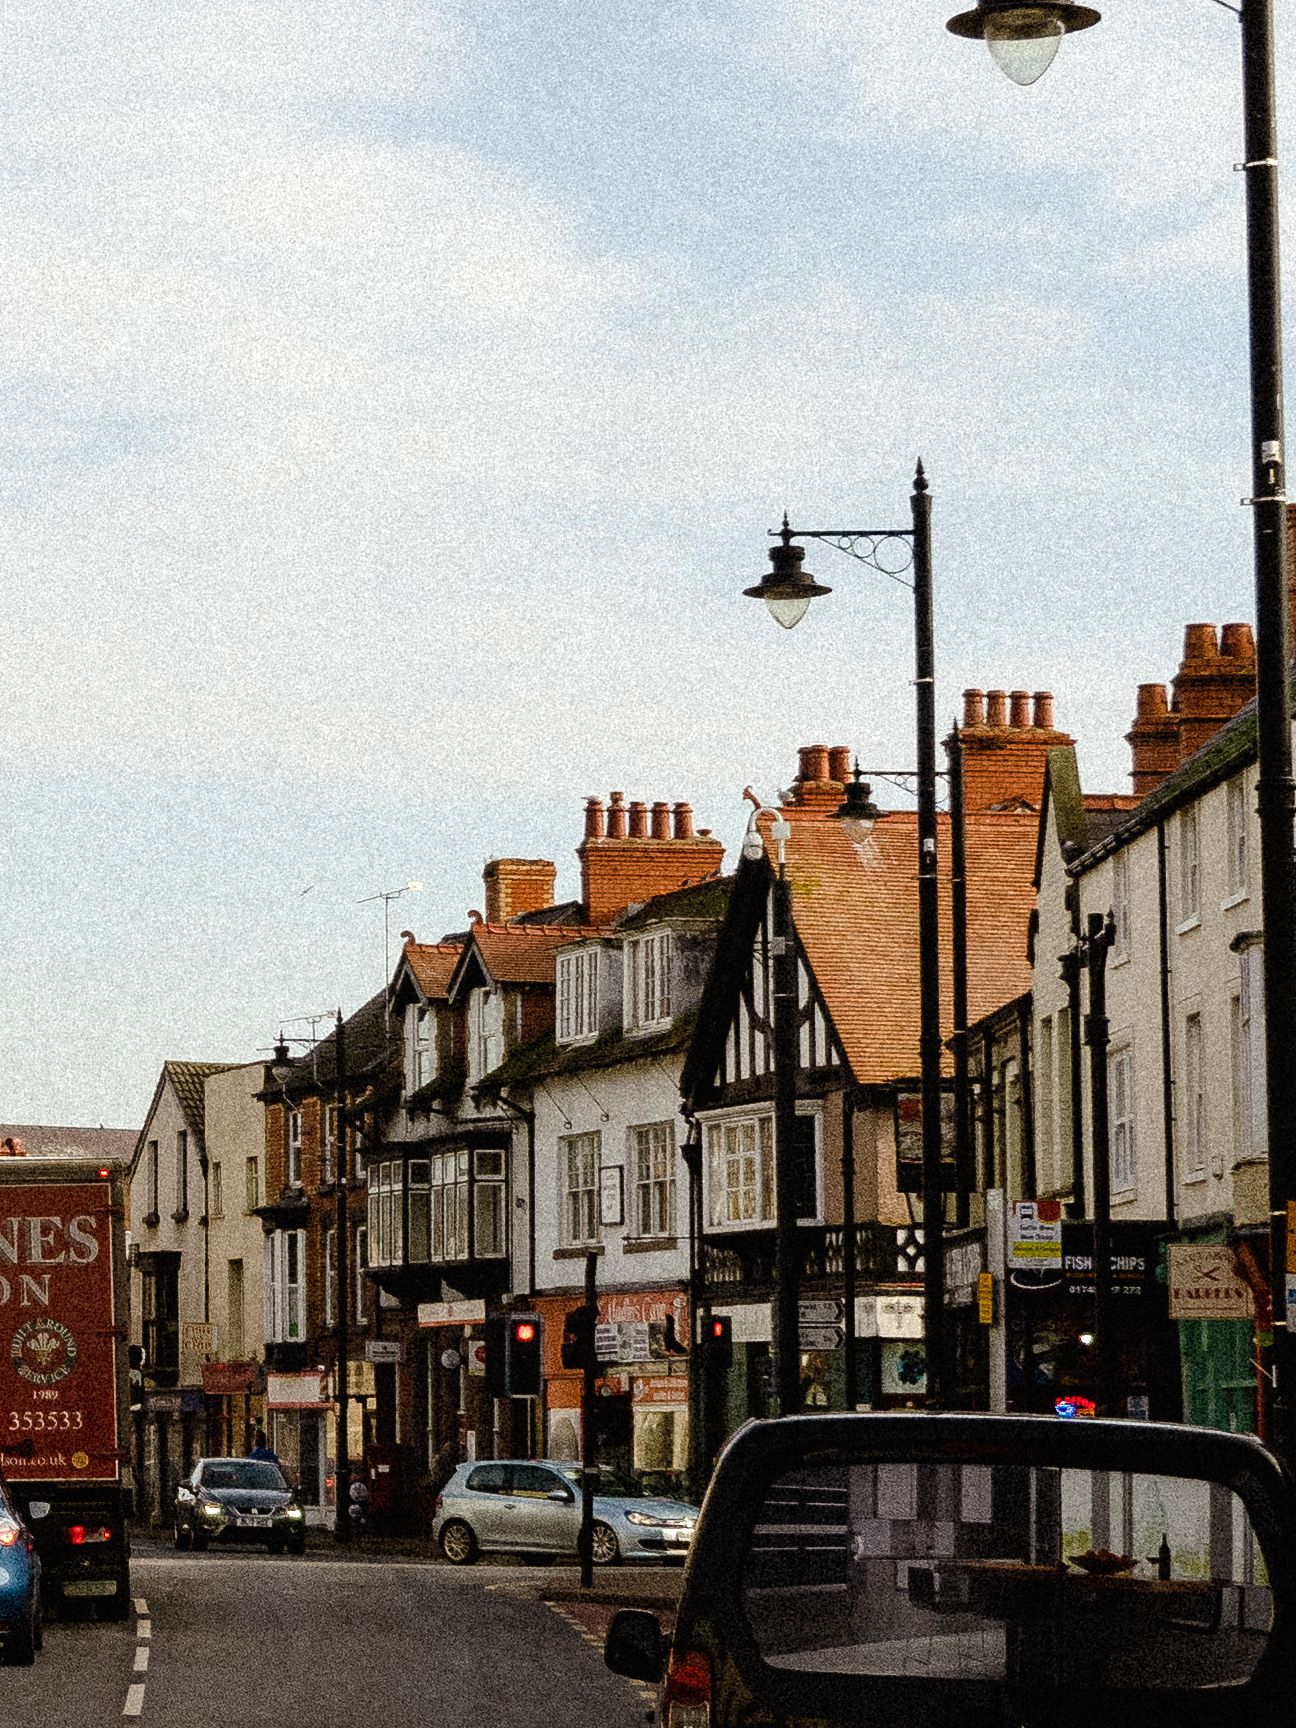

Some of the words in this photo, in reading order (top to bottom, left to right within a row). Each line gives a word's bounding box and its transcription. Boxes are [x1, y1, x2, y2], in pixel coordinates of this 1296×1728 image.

[1064, 1256, 1092, 1270] FISH
[32, 1389, 59, 1401] 1989
[8, 1410, 84, 1432] 353533
